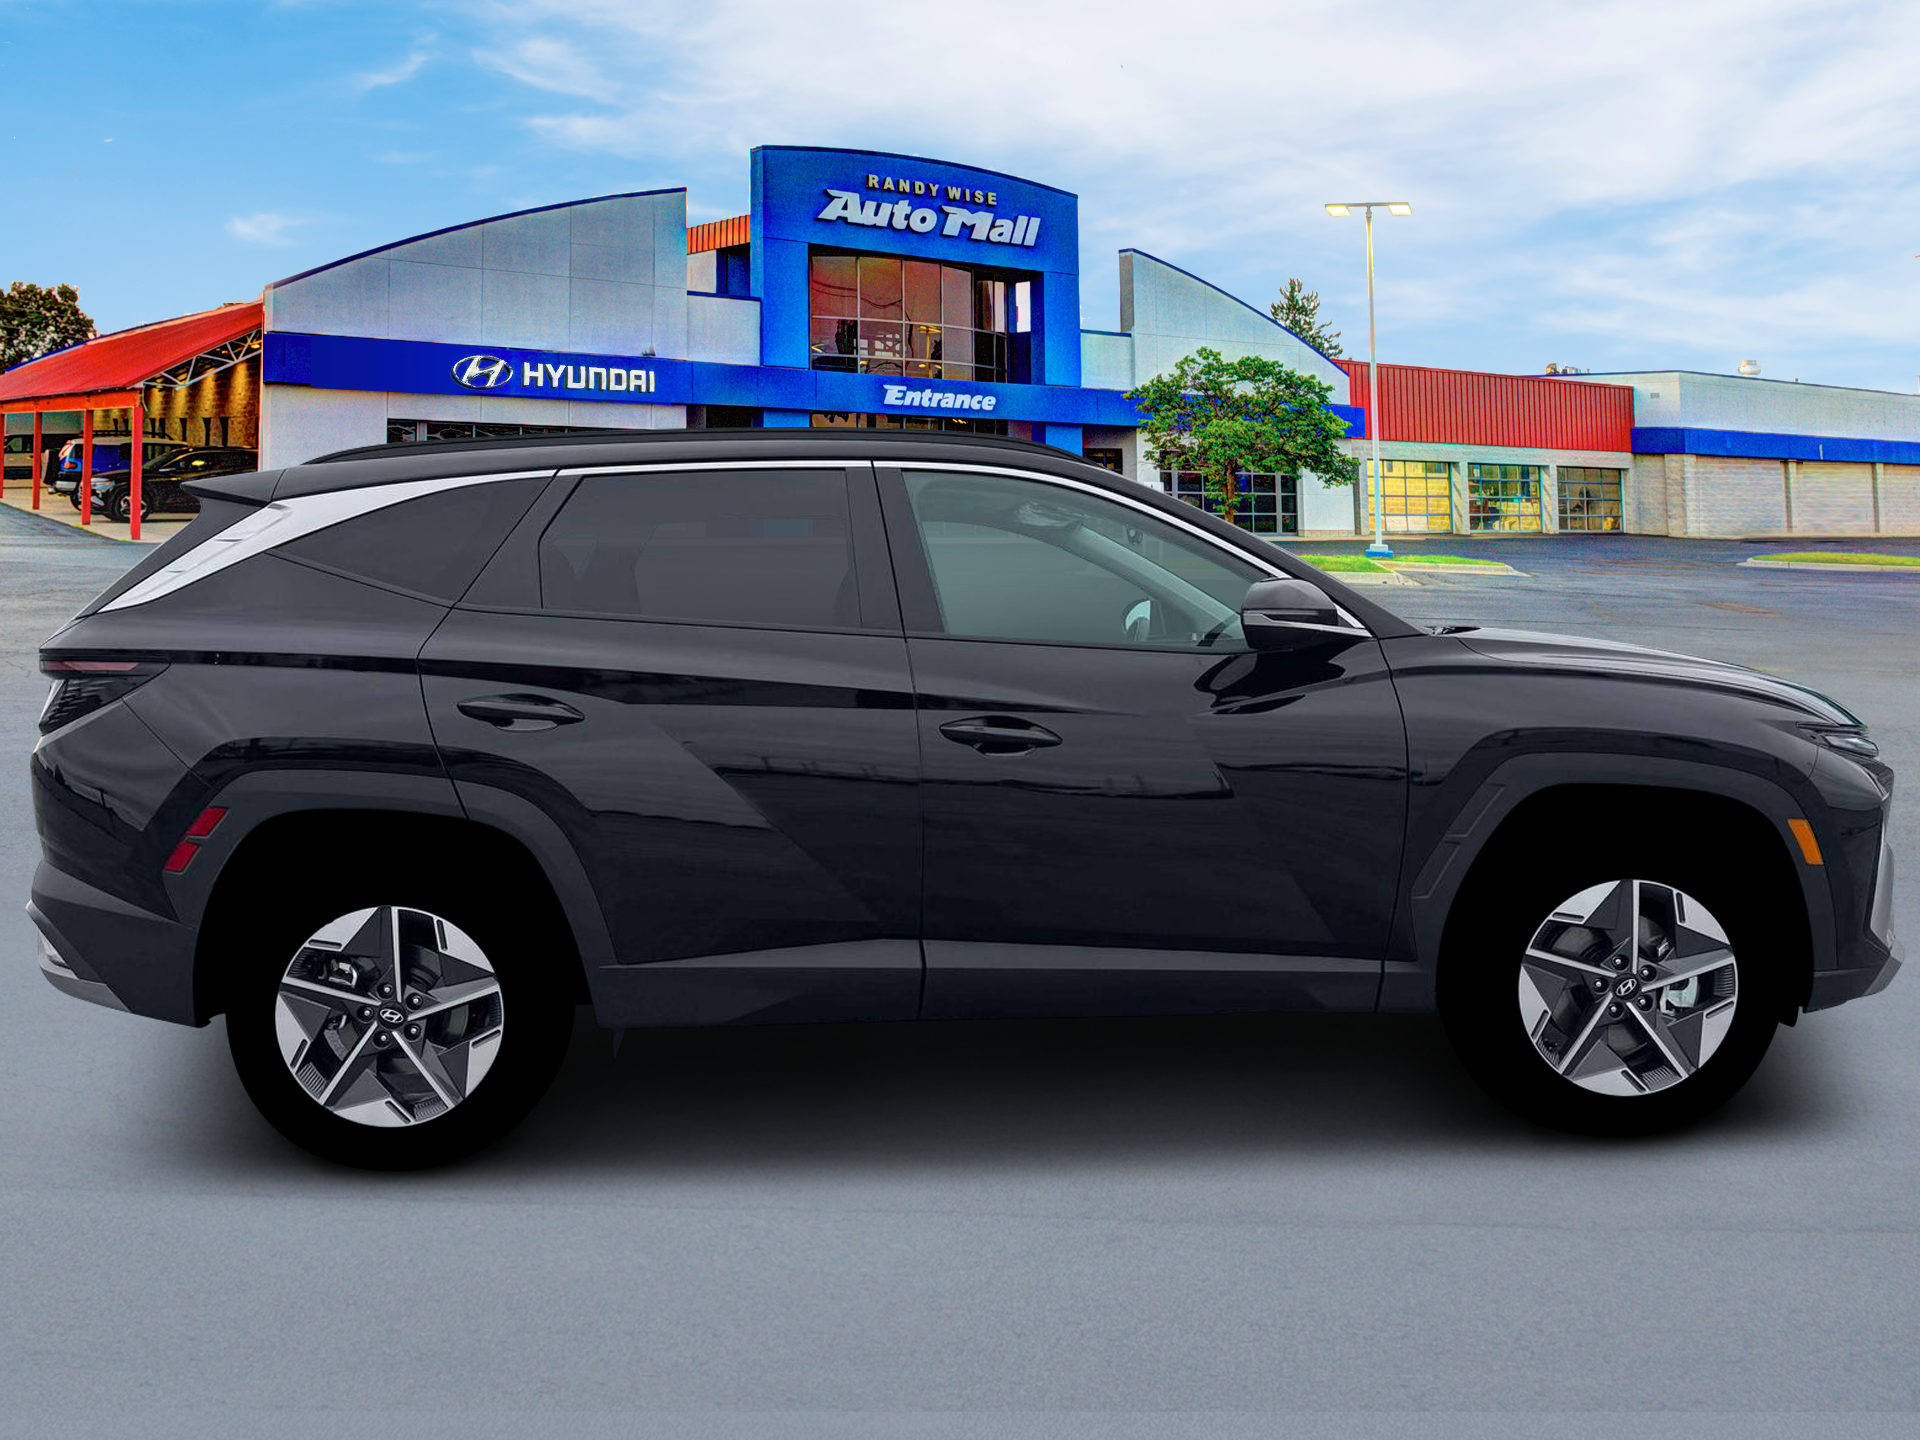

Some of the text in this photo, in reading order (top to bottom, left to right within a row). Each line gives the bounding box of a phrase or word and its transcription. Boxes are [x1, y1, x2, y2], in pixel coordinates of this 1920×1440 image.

[866, 173, 998, 206] RANDY WISE
[817, 189, 1041, 246] Auto Mall
[522, 362, 655, 393] HYUNDAI
[883, 385, 996, 411] Entrance
